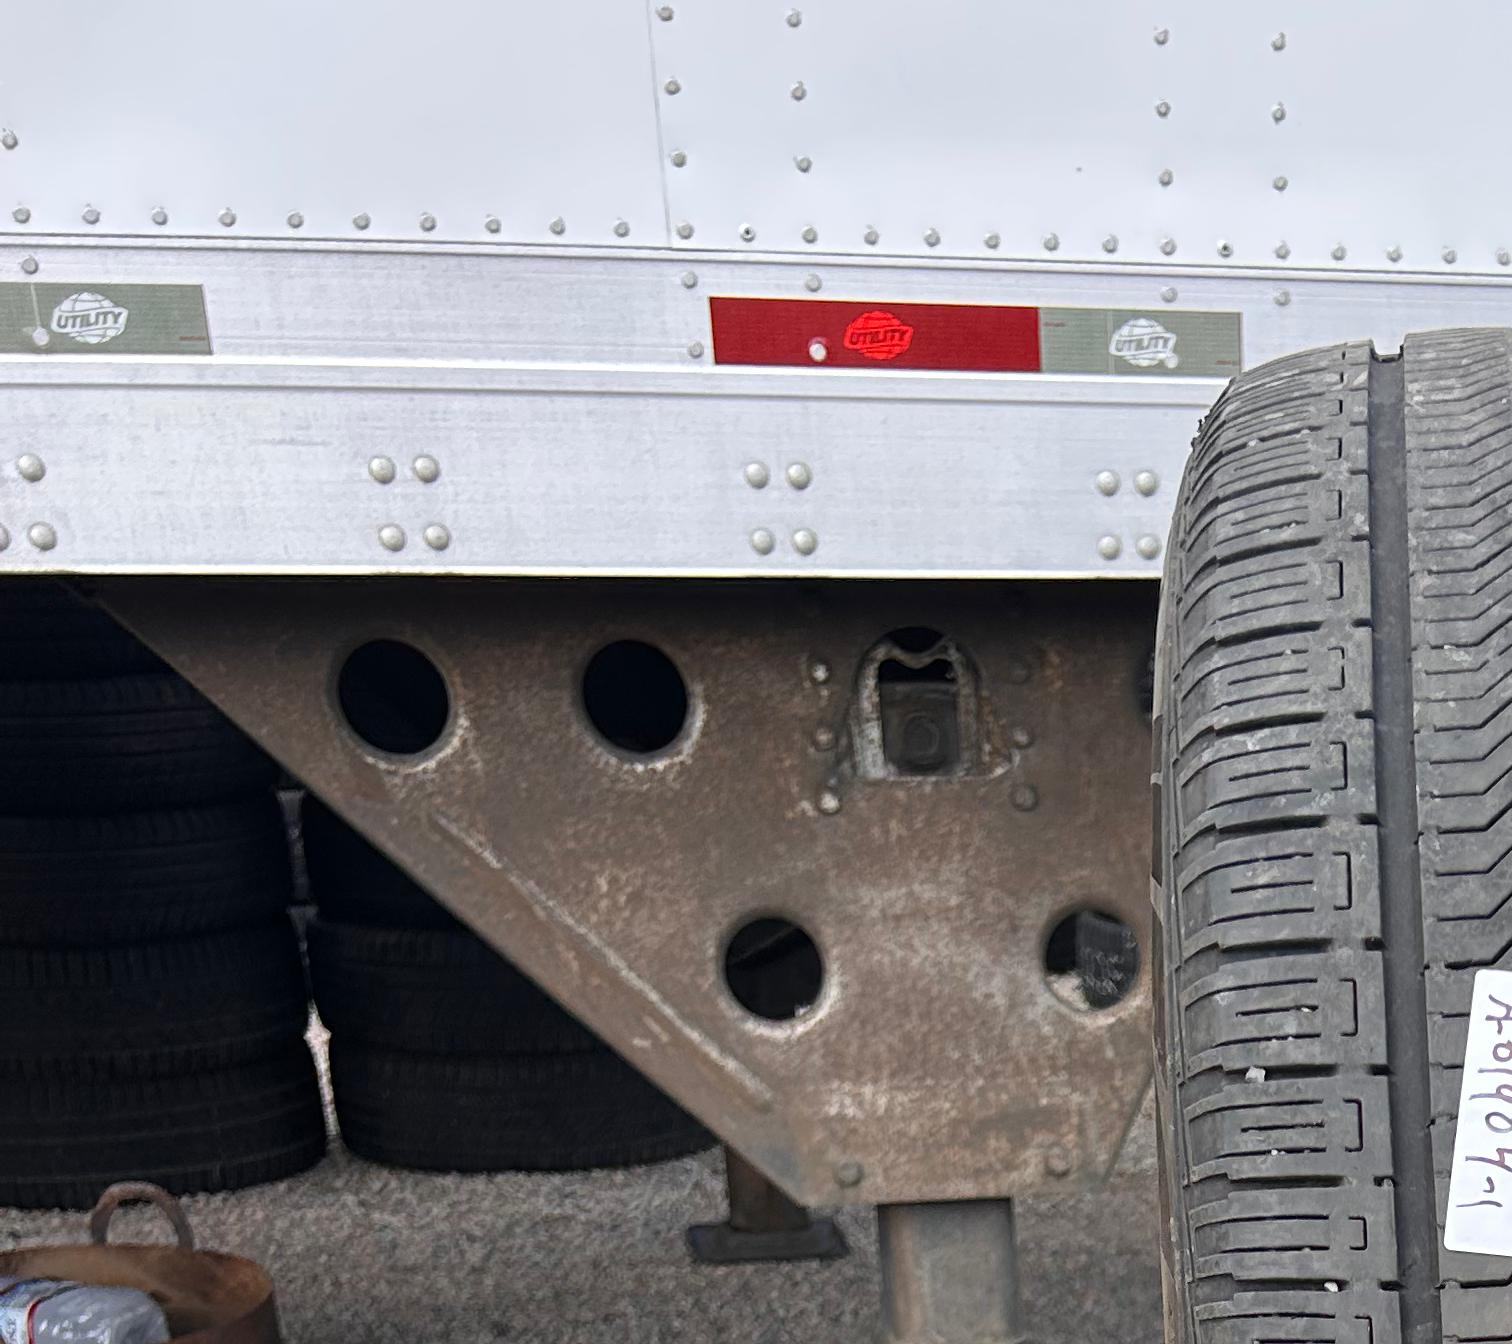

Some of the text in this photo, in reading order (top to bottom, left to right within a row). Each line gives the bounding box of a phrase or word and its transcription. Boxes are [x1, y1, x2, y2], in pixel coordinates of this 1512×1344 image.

[56, 310, 124, 330] UTILITY
[849, 327, 909, 347] UTILITY
[1114, 333, 1173, 355] UTILITY
